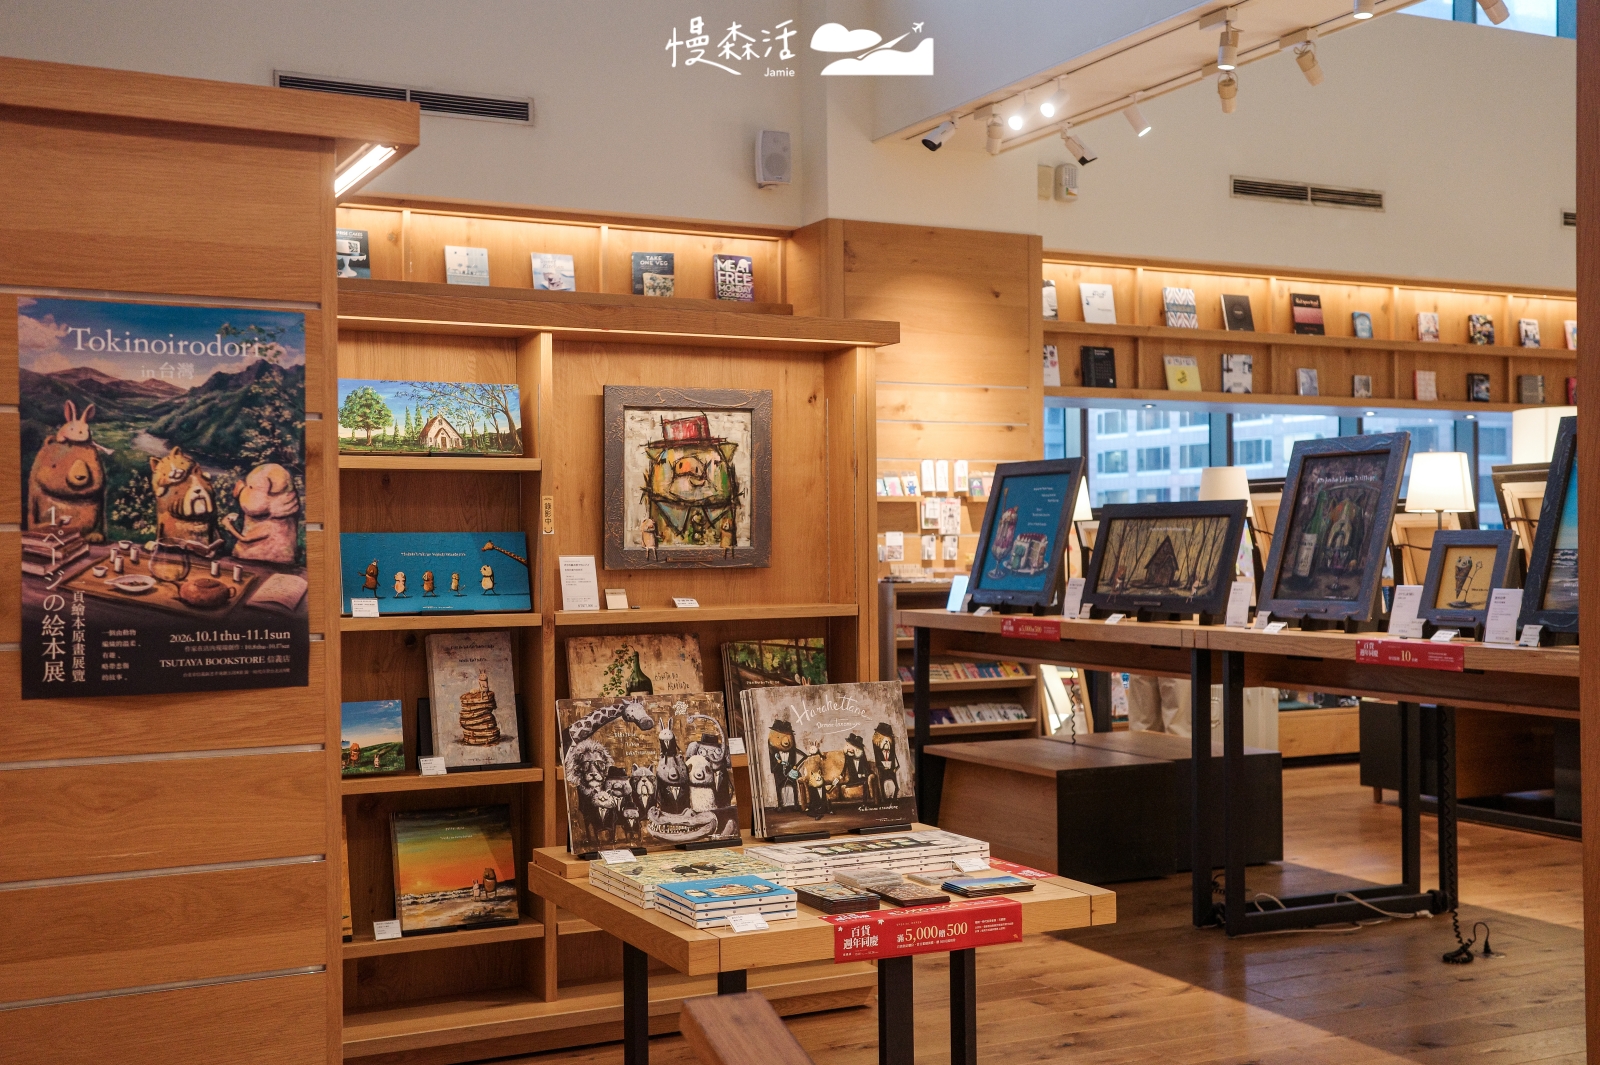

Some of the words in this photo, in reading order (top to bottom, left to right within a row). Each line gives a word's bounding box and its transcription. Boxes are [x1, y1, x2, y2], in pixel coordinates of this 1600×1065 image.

[717, 258, 751, 273] MEAT
[718, 271, 753, 285] FREE
[719, 284, 751, 294] MONDAY
[68, 326, 263, 358] Tokinoirodori
[141, 365, 155, 378] in
[159, 362, 195, 380] 台灣
[42, 506, 65, 682] 1ページの絵本展
[160, 658, 203, 668] TSUTAYA
[205, 656, 266, 666] BOOKSTORE
[1401, 650, 1412, 662] 10
[851, 925, 871, 938] 百貨
[843, 937, 879, 950] 週年同慶
